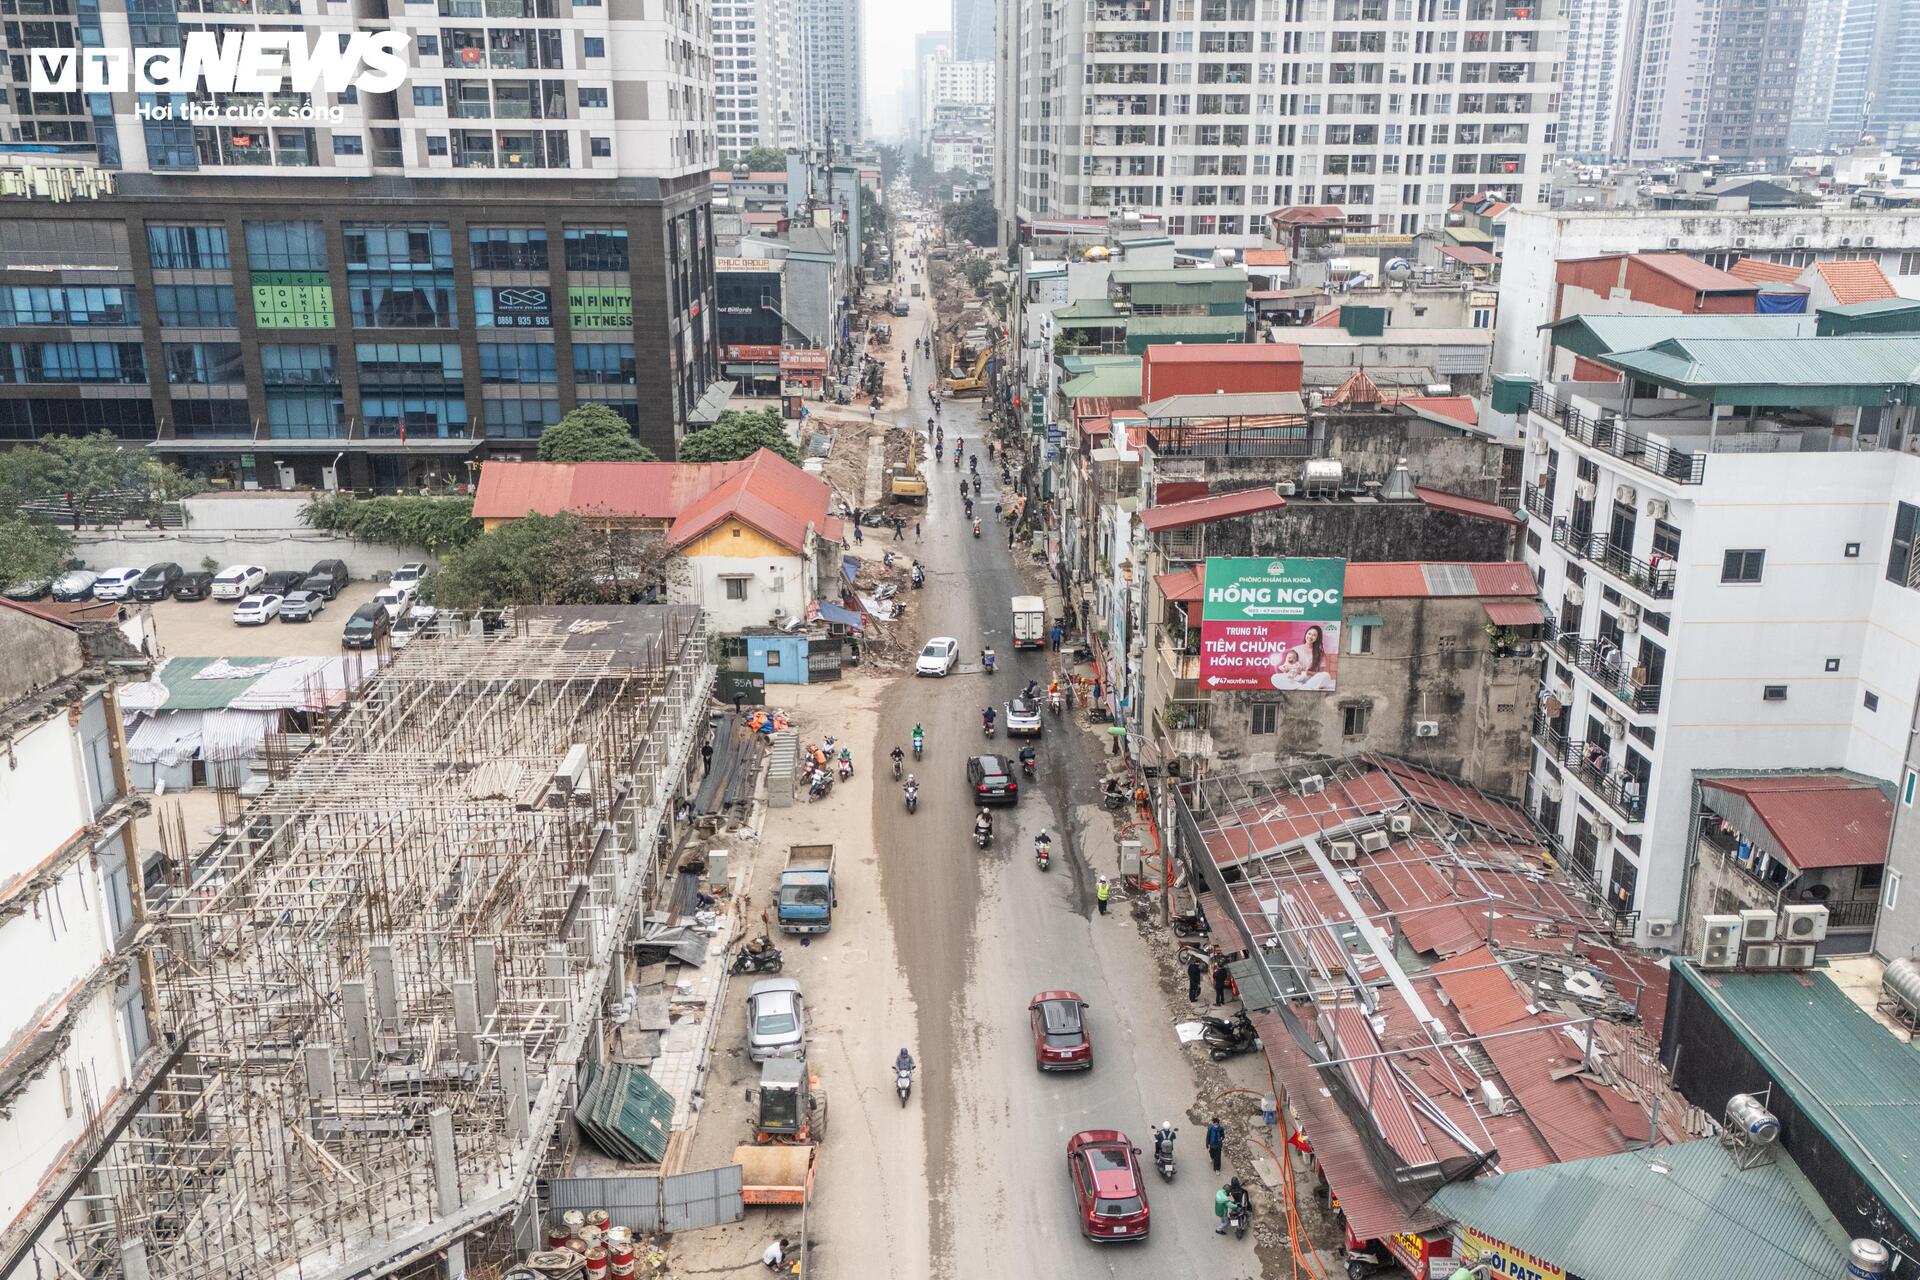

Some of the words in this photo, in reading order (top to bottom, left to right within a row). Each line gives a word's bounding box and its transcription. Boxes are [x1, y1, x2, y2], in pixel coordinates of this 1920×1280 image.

[574, 315, 633, 326] FITNESS
[1208, 582, 1271, 603] HỒNG
[1277, 588, 1339, 607] NGỌC
[1226, 626, 1251, 636] TRUNG
[1253, 625, 1268, 636] TÂM
[1205, 638, 1236, 653] TIÊM
[1239, 638, 1286, 653] CHỦNG
